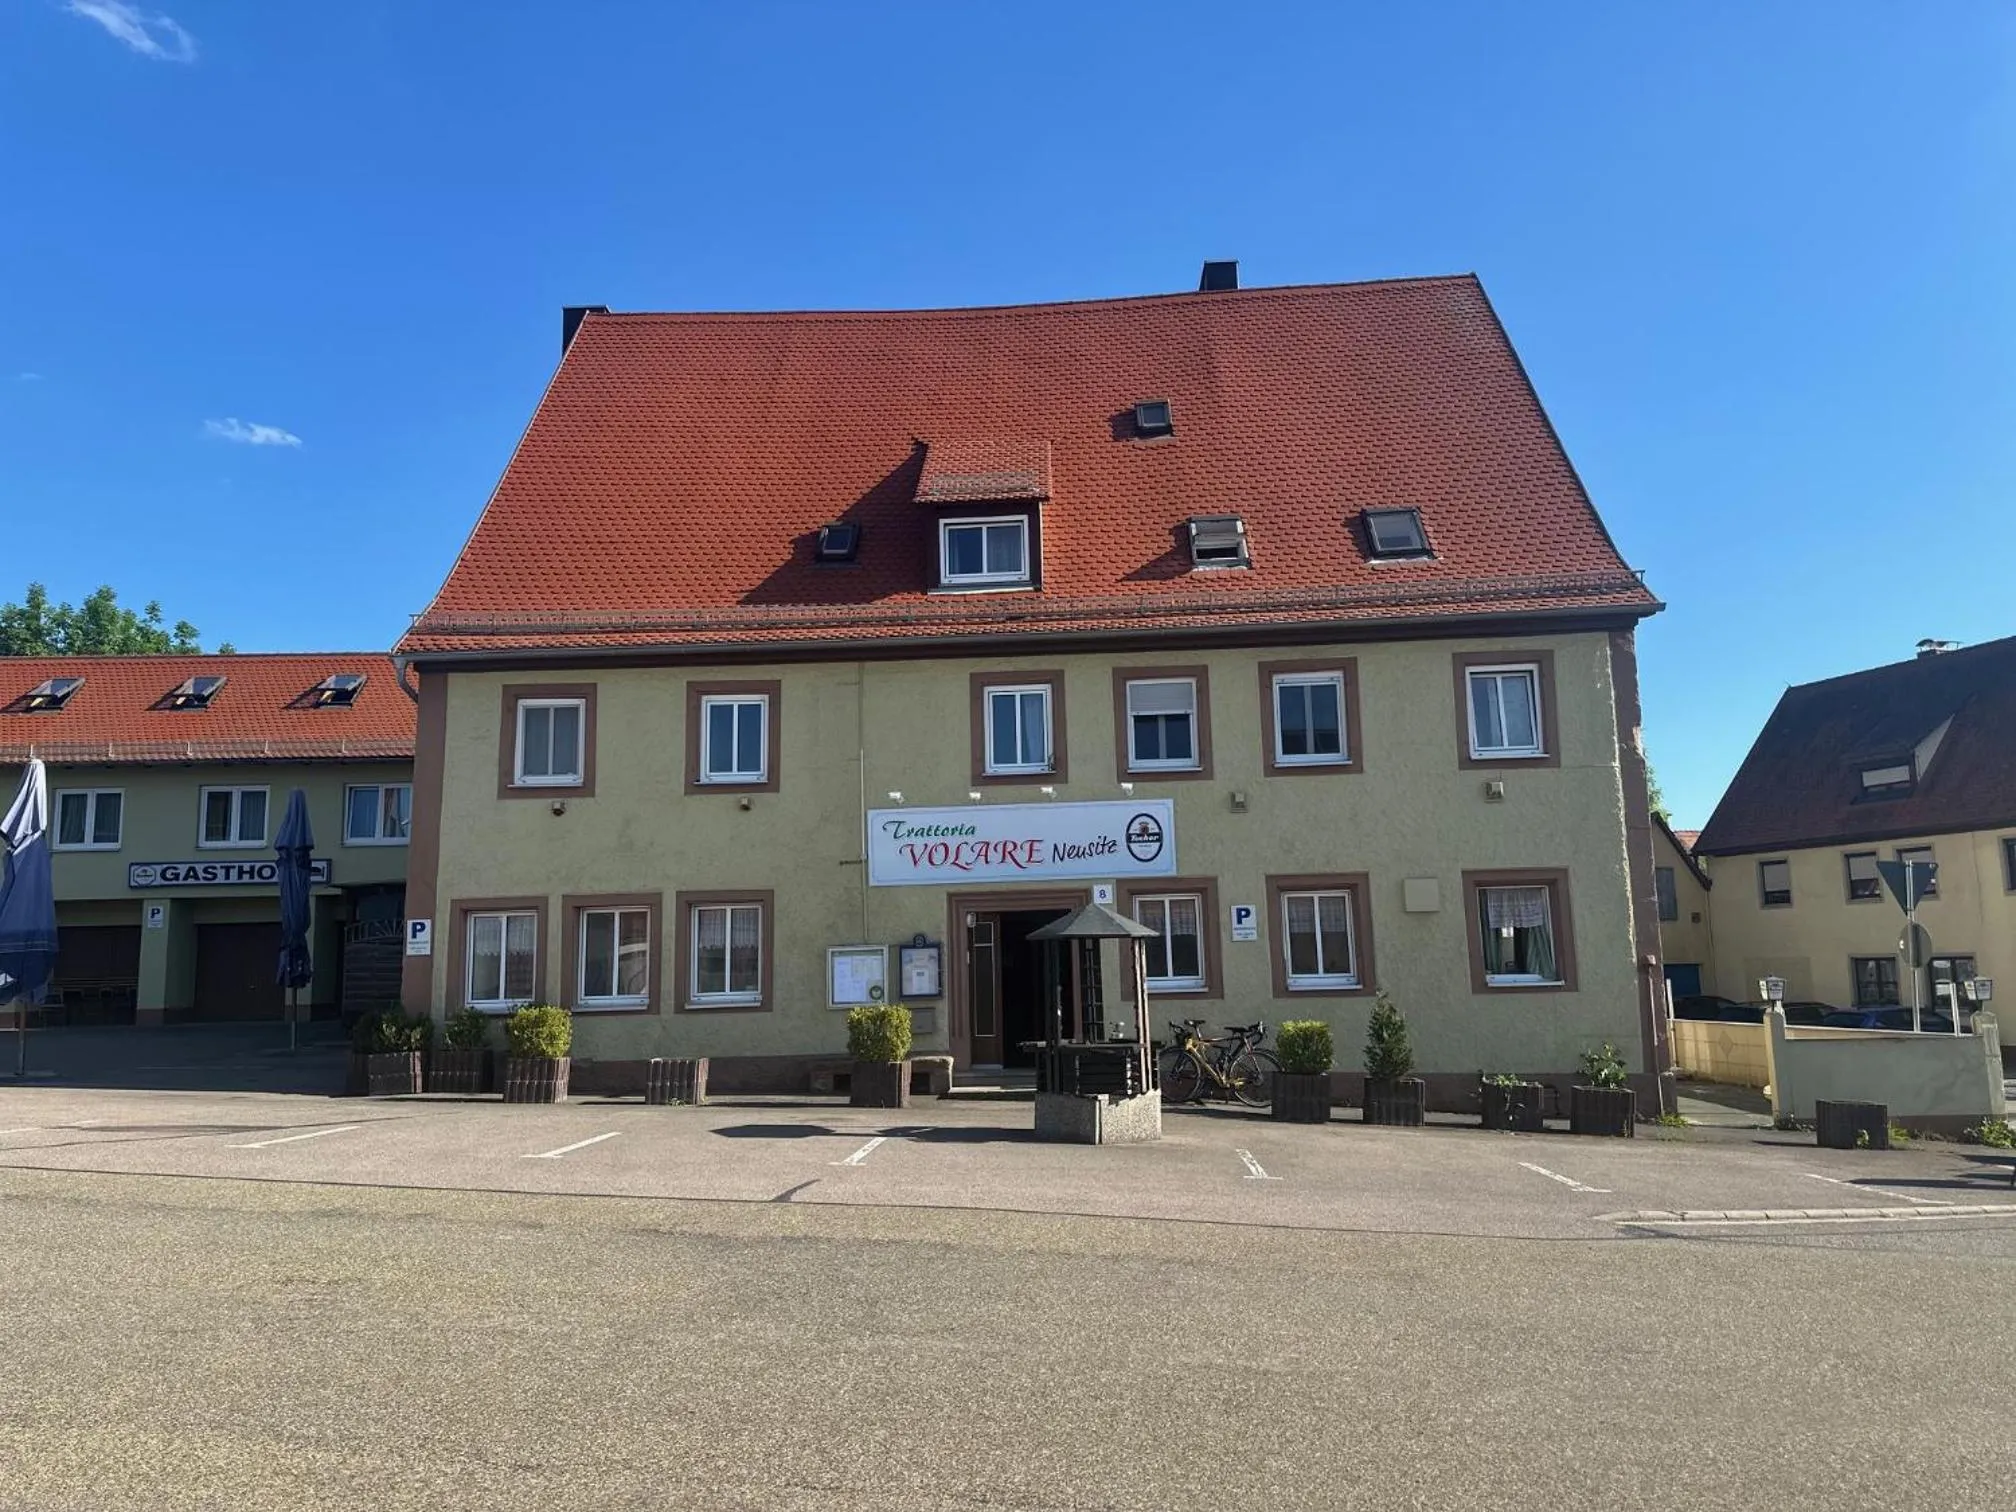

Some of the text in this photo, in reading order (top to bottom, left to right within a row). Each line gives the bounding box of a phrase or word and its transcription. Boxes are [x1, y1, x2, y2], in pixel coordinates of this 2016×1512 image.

[882, 820, 976, 840] Trattoria
[899, 839, 1045, 871] VOLARE
[160, 864, 277, 882] GASTHO
[1098, 889, 1106, 900] 8
[1236, 907, 1251, 925] P
[411, 922, 426, 939] P
